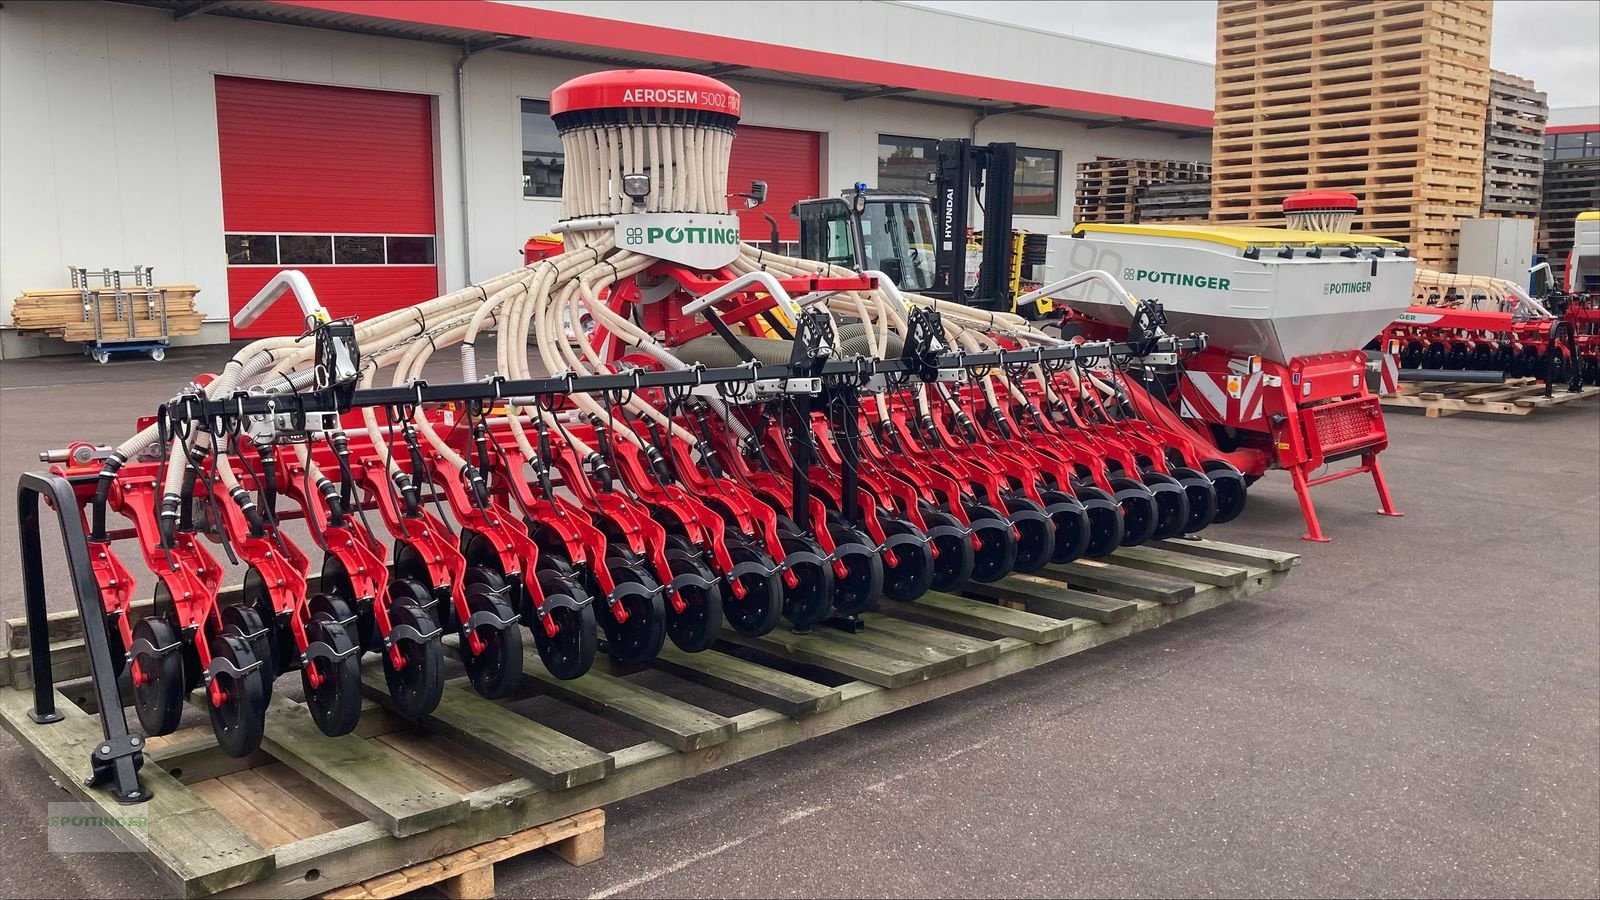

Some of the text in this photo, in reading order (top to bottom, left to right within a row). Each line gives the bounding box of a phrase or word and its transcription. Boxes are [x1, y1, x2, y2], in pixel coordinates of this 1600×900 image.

[623, 89, 698, 104] AEROSEM
[701, 92, 726, 108] 5002
[945, 188, 954, 238] HYUNDAI
[1136, 270, 1231, 291] PÖTTINGER
